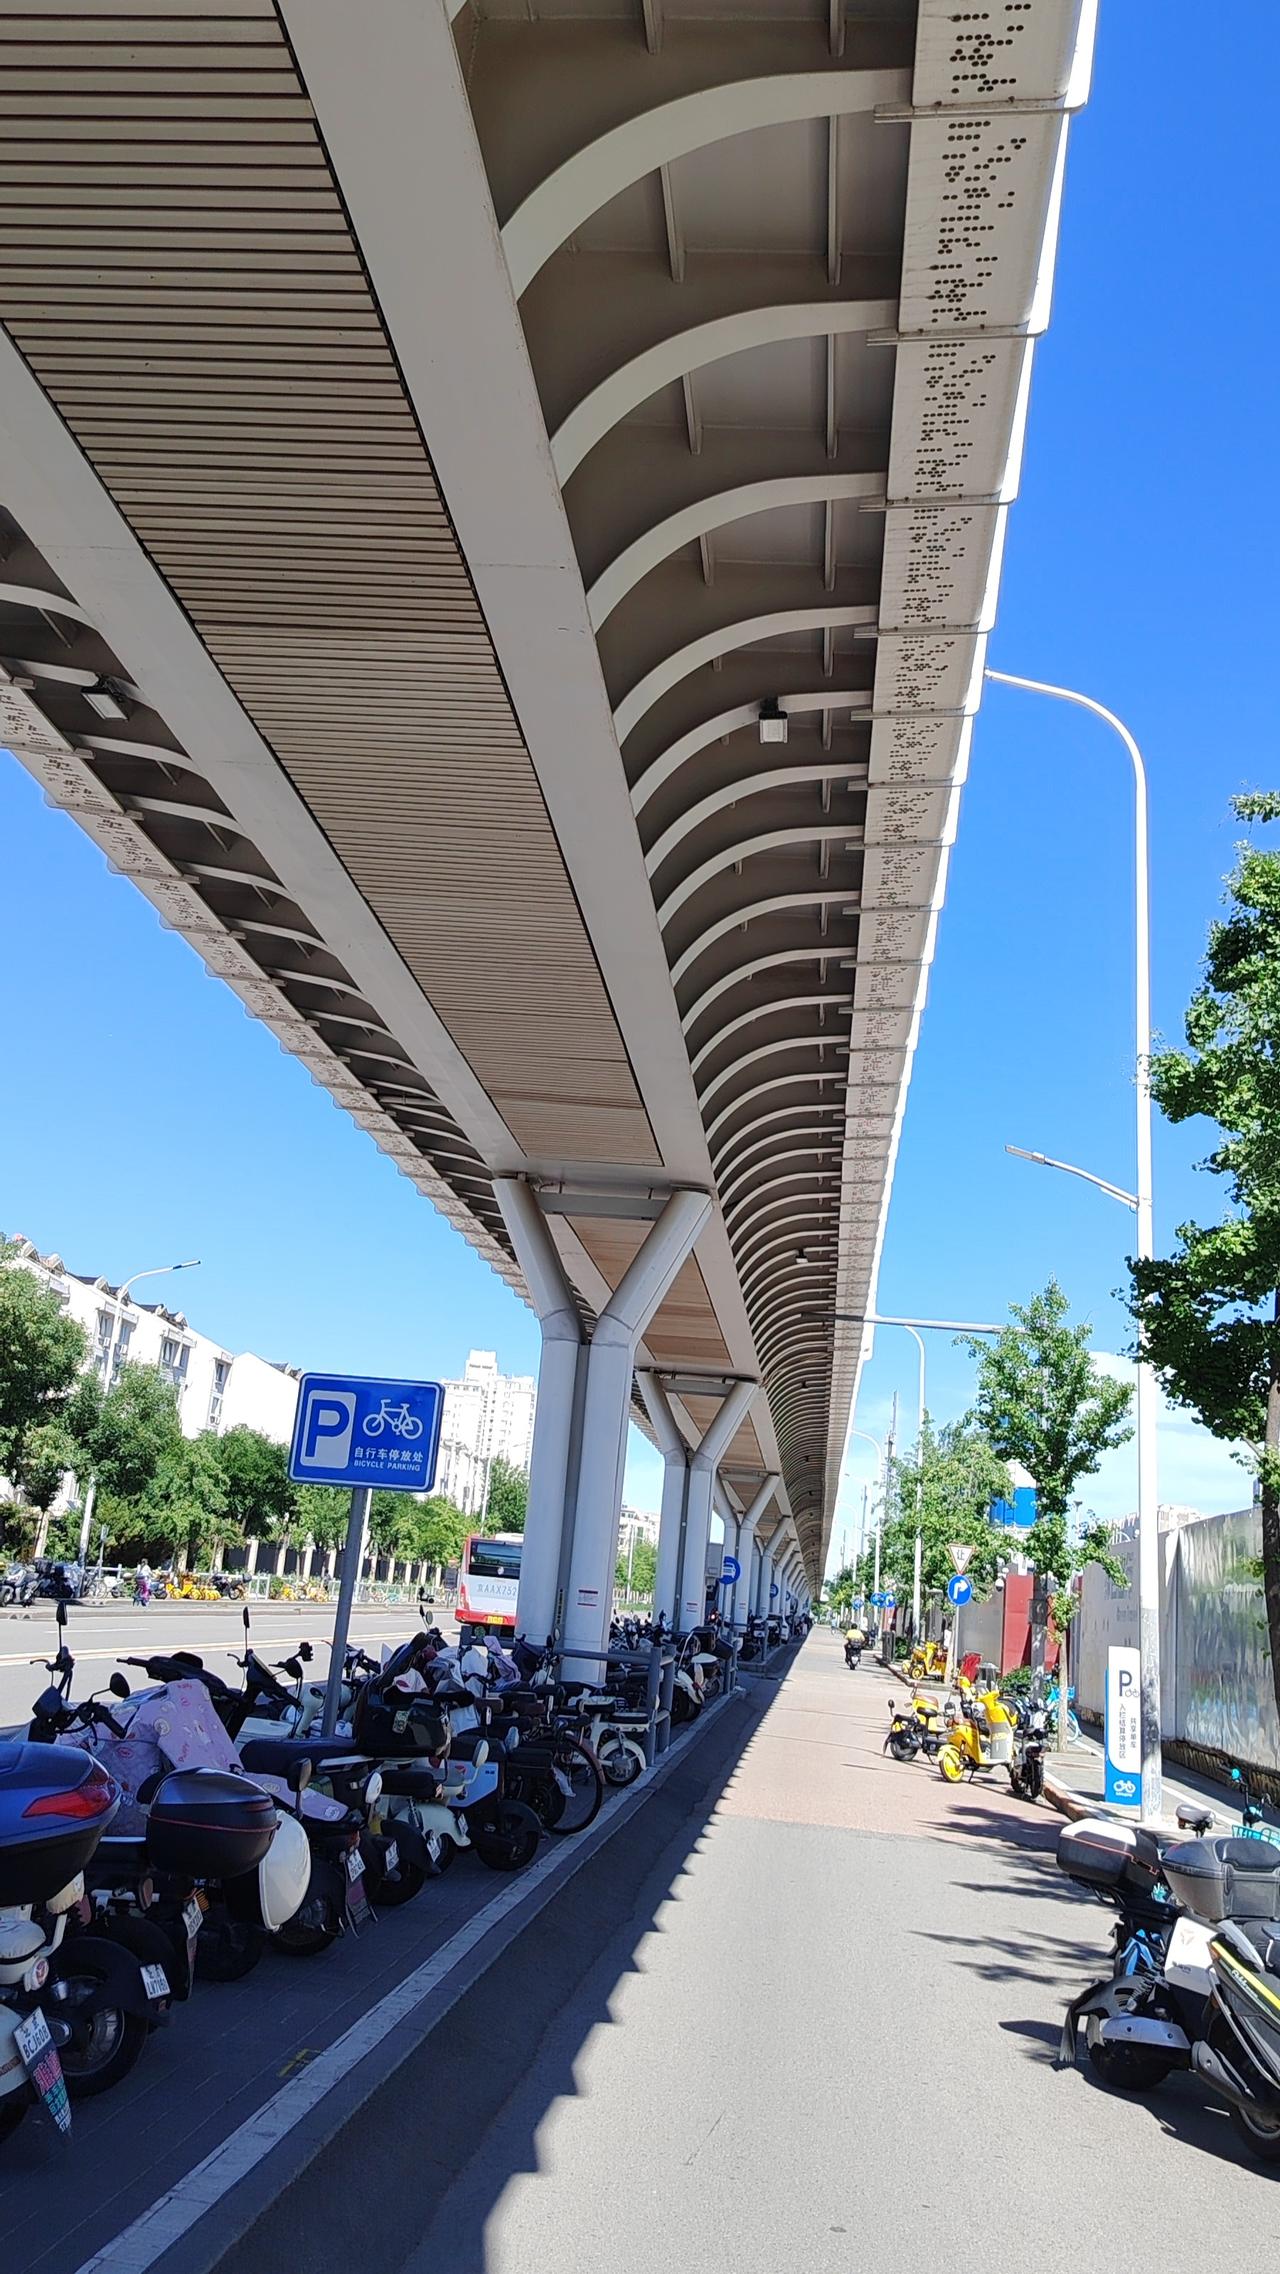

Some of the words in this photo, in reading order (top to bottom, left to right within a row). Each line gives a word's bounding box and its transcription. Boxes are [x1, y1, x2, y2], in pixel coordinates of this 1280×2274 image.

[305, 1399, 350, 1457] P
[354, 1446, 424, 1463] 自行车停放处
[353, 1460, 384, 1469] BICYCLE
[387, 1463, 421, 1472] PARKING
[1119, 1670, 1132, 1697] P
